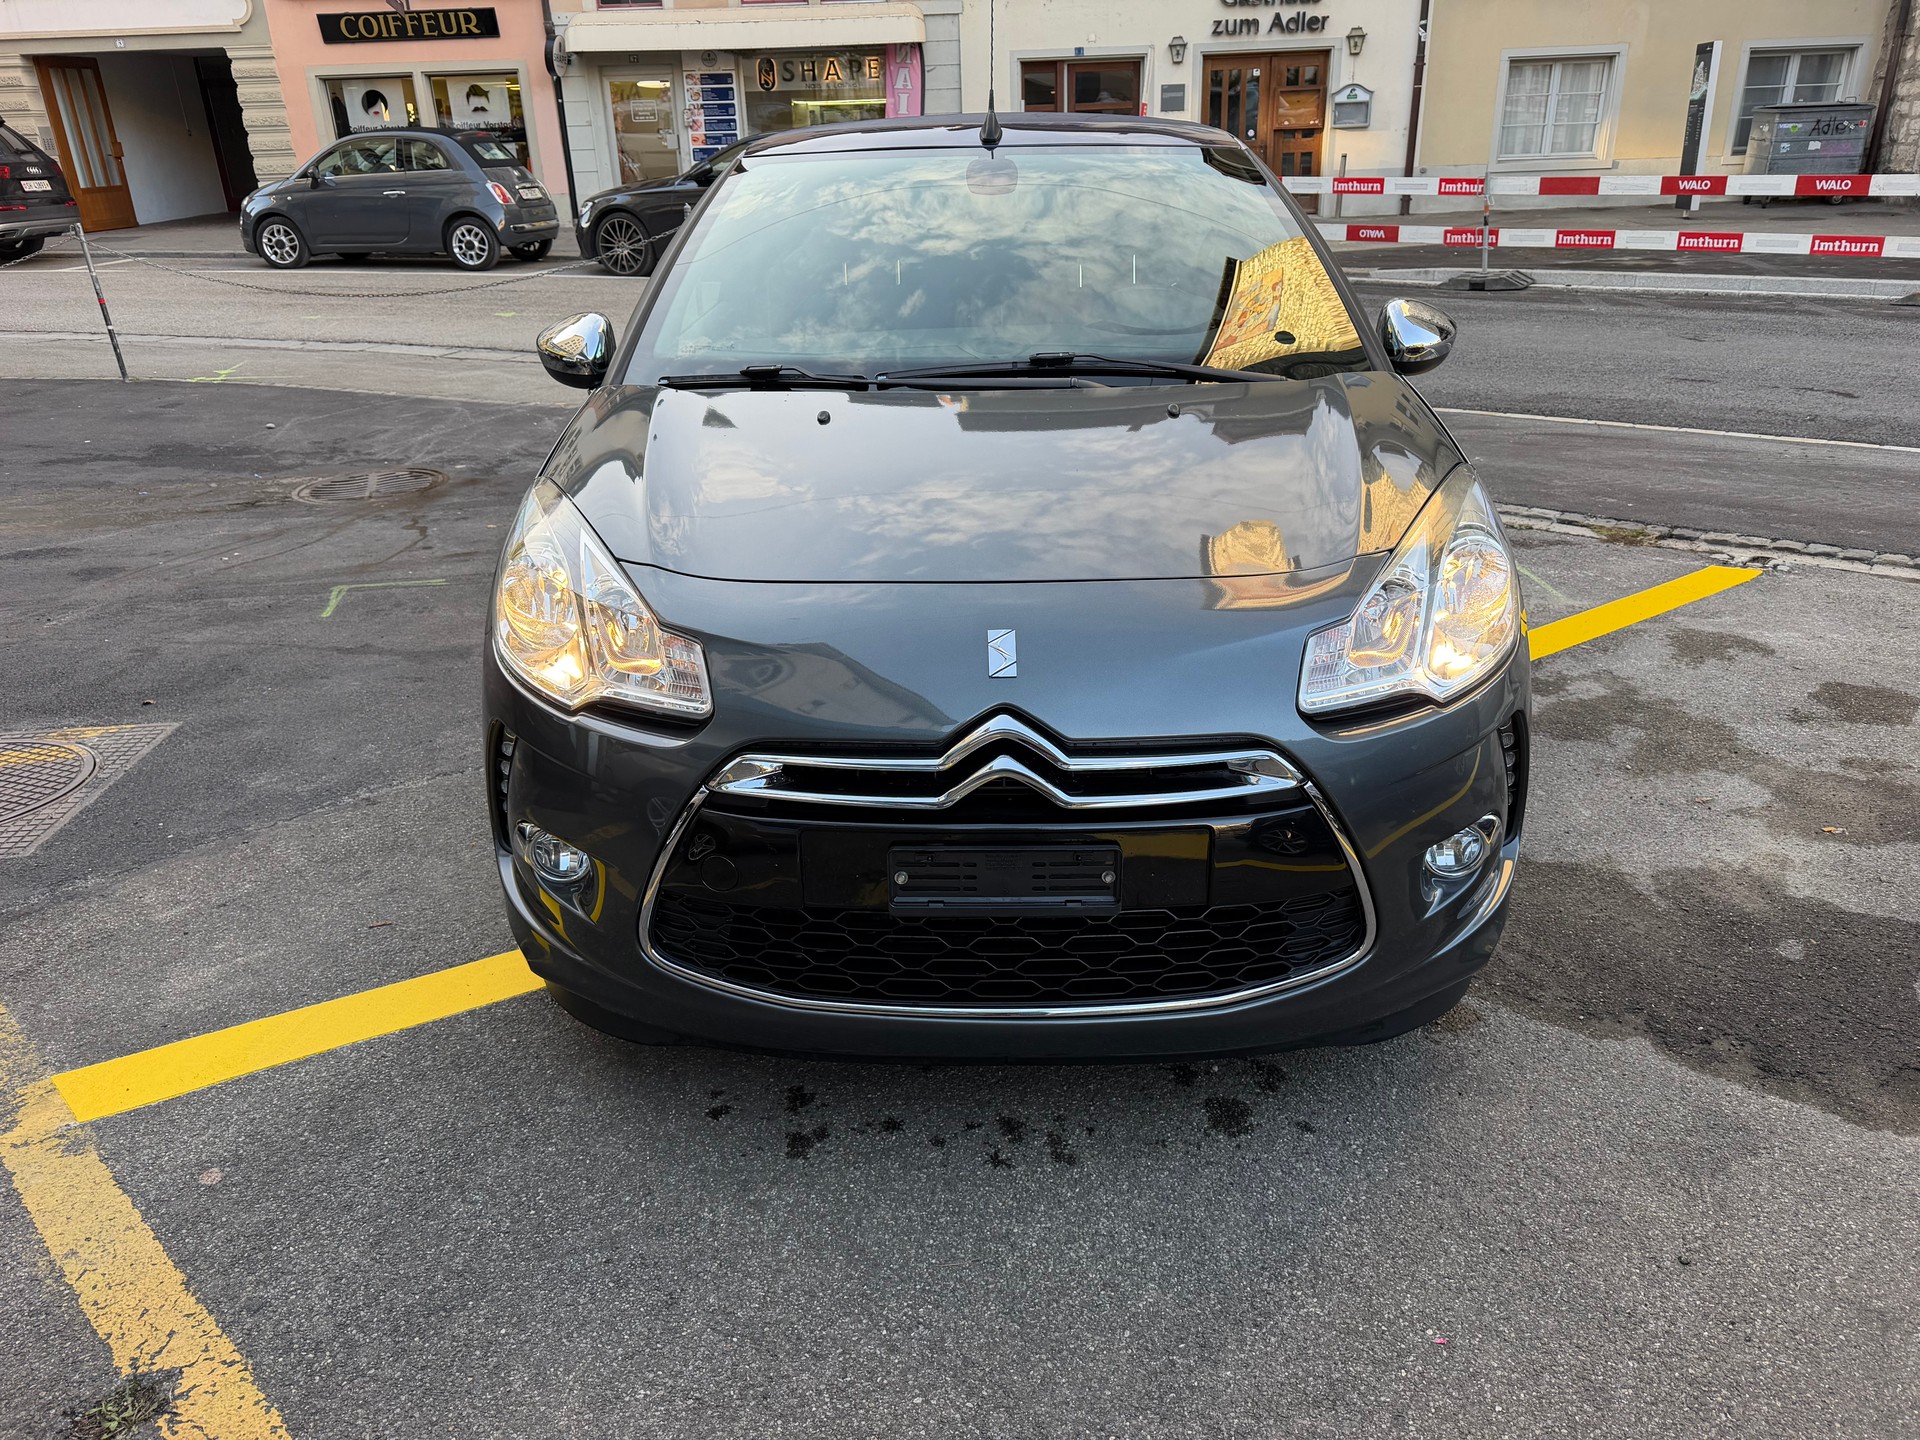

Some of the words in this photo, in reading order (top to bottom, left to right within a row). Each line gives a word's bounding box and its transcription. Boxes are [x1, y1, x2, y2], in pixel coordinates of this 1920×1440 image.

[339, 11, 481, 39] COIFFEUR
[1211, 18, 1260, 36] zum
[1267, 11, 1330, 34] Adler
[781, 58, 881, 82] SHAPE
[1333, 181, 1381, 192] Imthurn
[1678, 179, 1711, 191] WALO
[1815, 179, 1852, 191] WALO
[1359, 229, 1385, 239] WALO
[1446, 232, 1497, 244] Imthun
[1557, 233, 1612, 245] Imthurn
[1679, 236, 1739, 249] Imthurn
[1813, 239, 1879, 253] Imthurn
